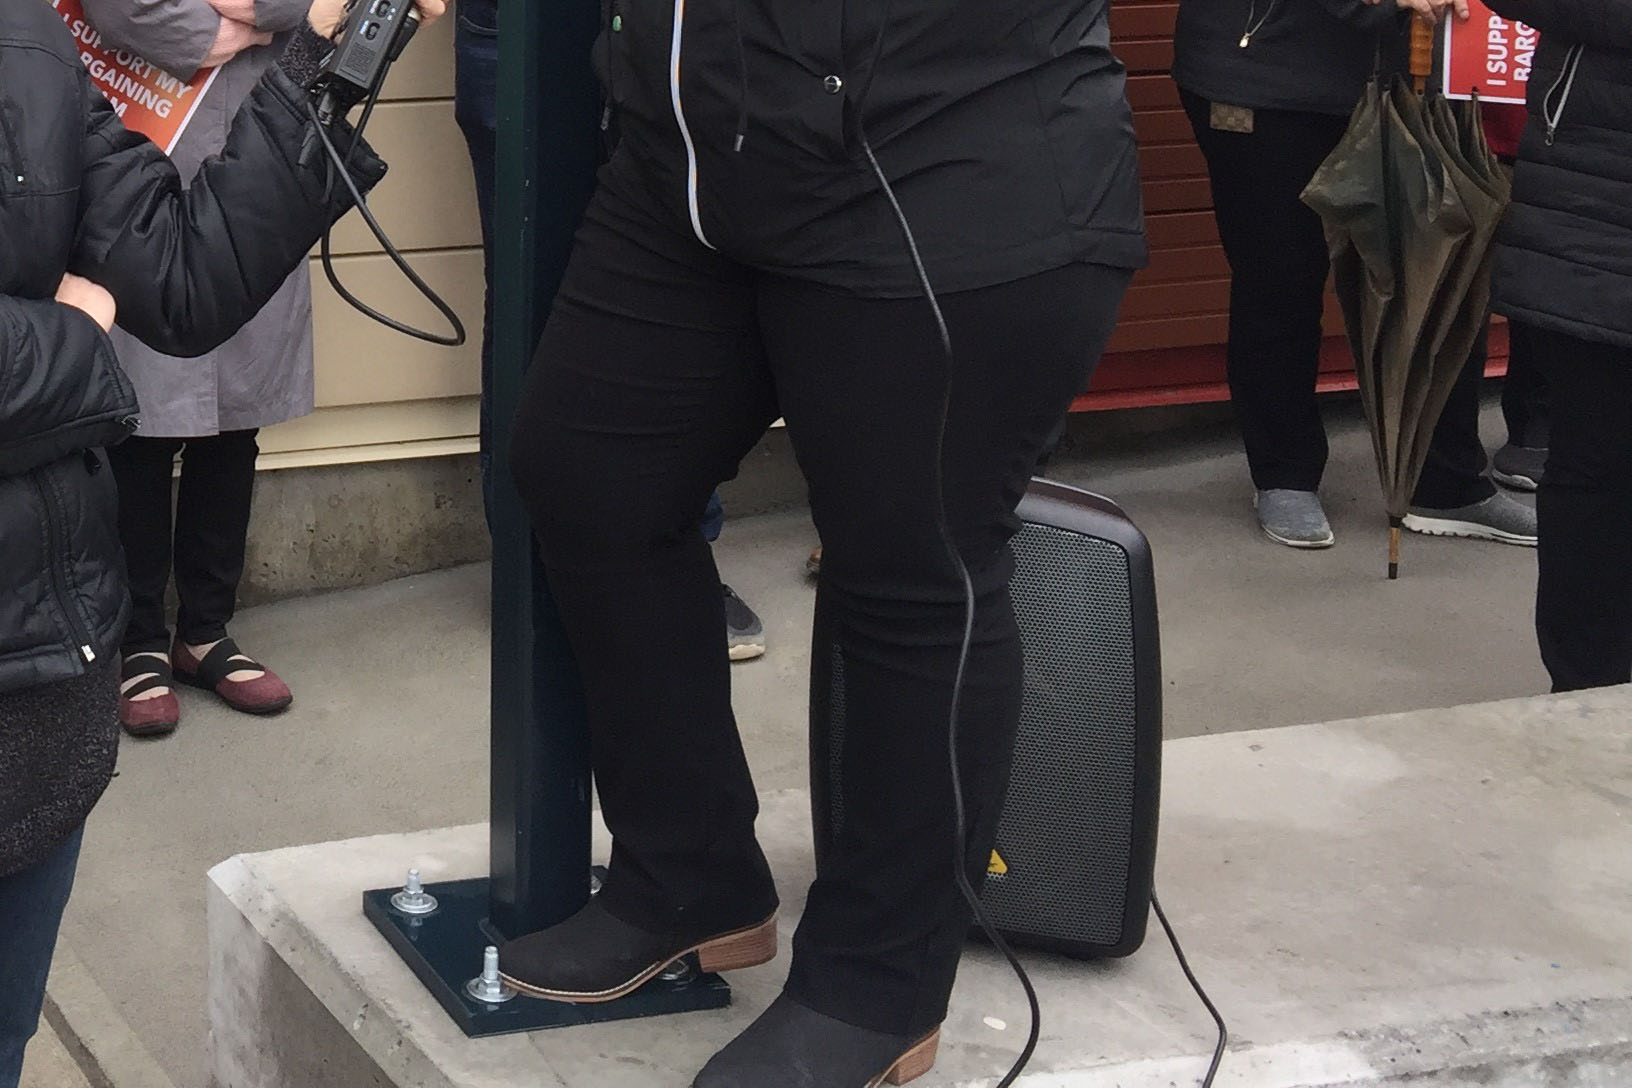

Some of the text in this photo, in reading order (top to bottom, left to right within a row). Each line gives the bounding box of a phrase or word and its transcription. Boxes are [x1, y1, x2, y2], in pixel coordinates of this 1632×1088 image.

[1486, 11, 1508, 74] SUPP
[80, 51, 173, 118] RGAINING
[154, 73, 192, 99] MY
